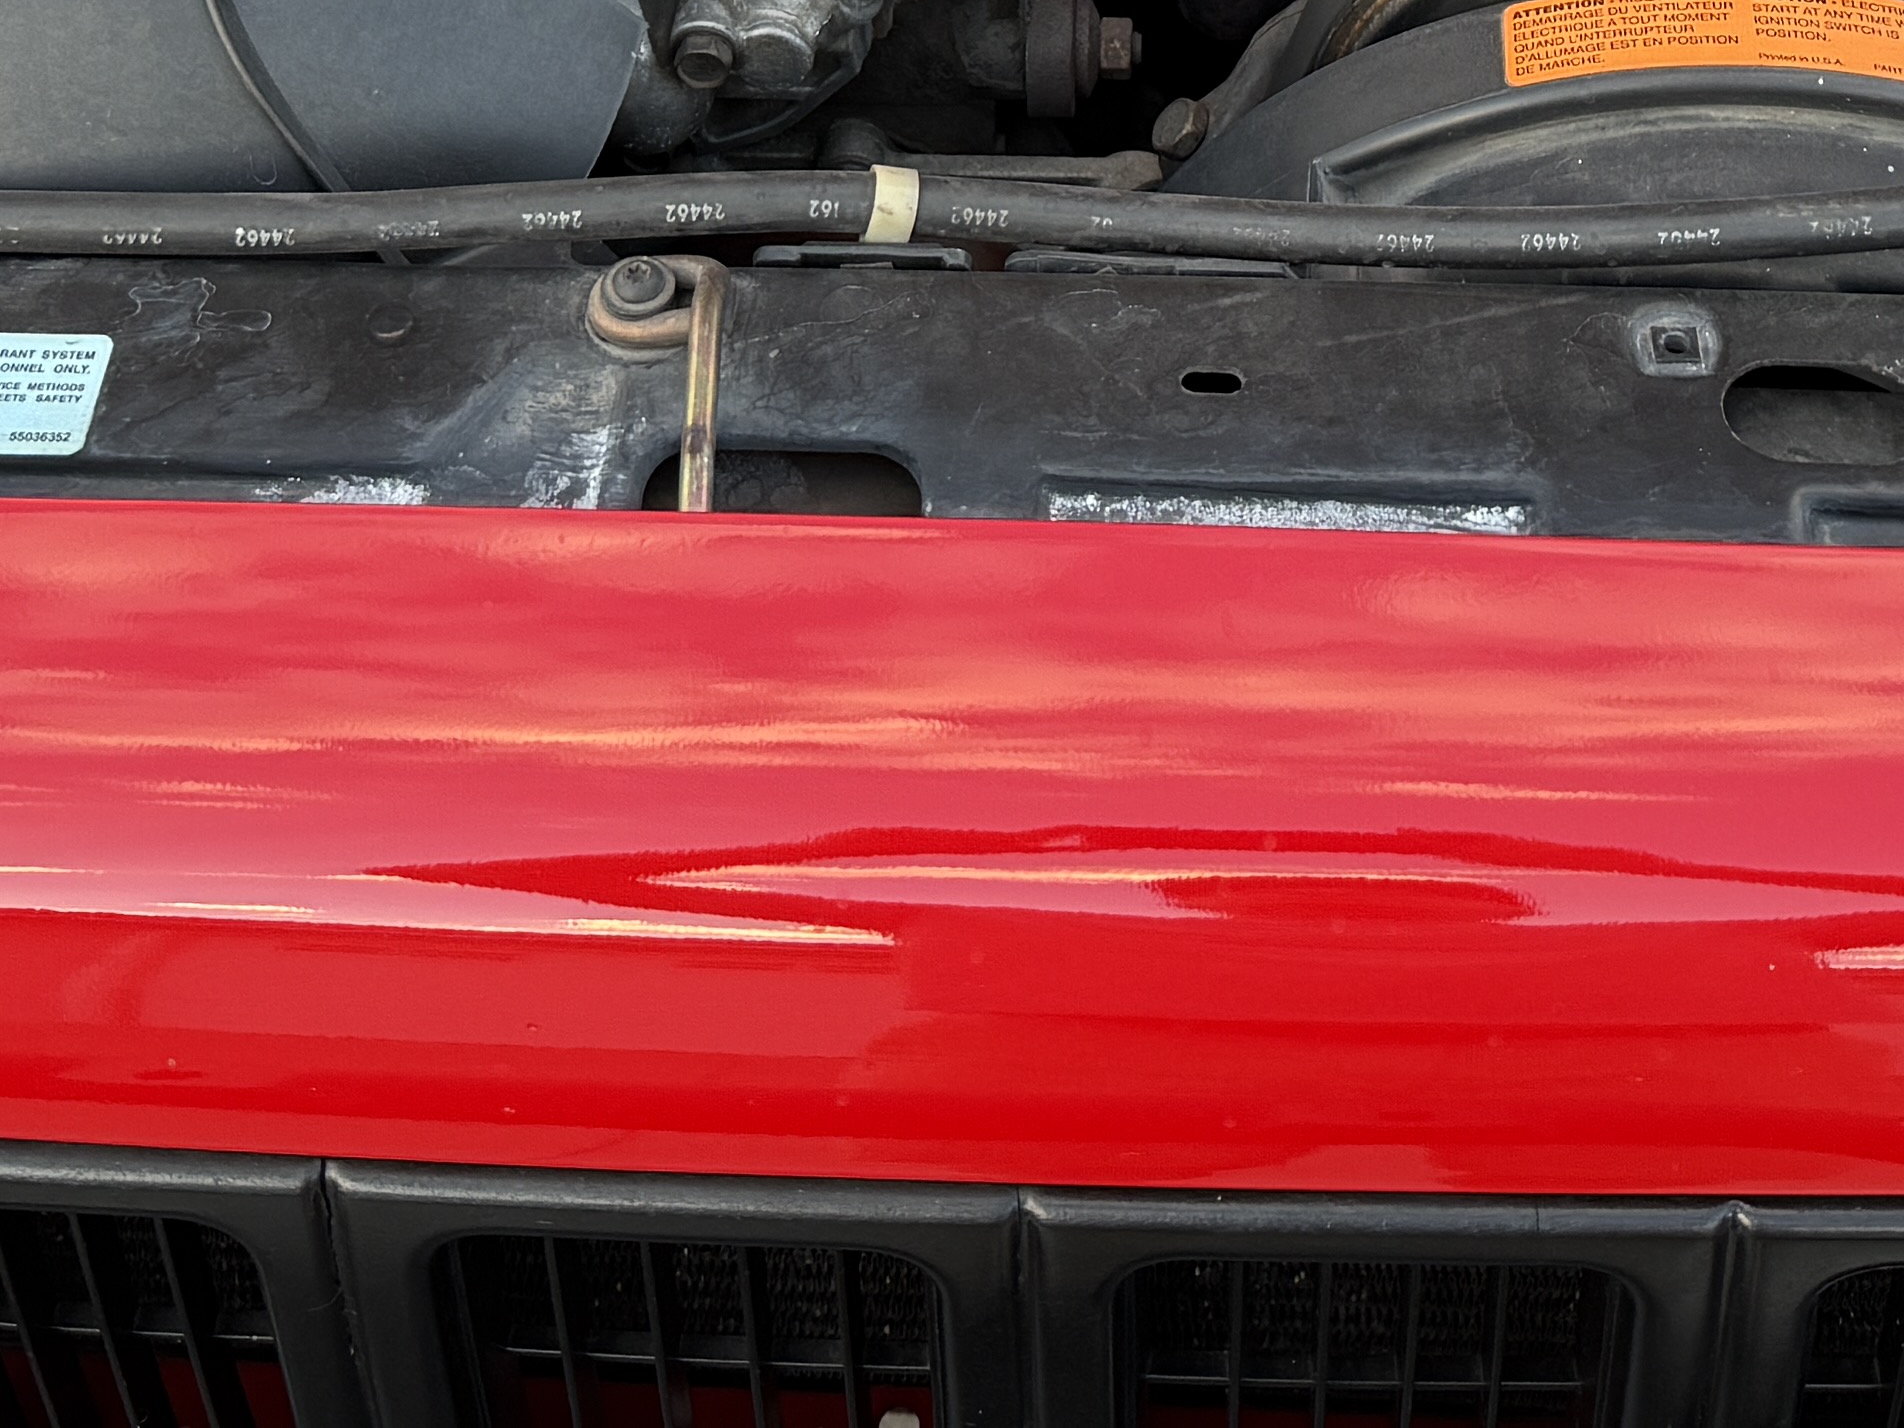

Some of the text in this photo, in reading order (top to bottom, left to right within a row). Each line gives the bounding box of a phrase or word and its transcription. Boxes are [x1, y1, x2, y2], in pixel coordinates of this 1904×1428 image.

[1513, 0, 1734, 30] DEMARRAGE DU VENTILATEUR
[1753, 3, 1802, 14] START
[1802, 5, 1820, 17] AT
[1823, 8, 1852, 22] ANY
[1855, 12, 1891, 27] TIME
[1514, 21, 1606, 42] ELECTRIQUE
[1620, 14, 1659, 26] TOUT
[1663, 12, 1730, 23] MOMENT
[1753, 15, 1820, 31] IGNITION
[1823, 21, 1882, 38] SWITCH
[1885, 29, 1900, 39] IS
[1755, 28, 1832, 43] POSITION.
[1515, 24, 1694, 54] QUAND L'INTERRUPTEUR
[1516, 34, 1739, 64] D'ALLUMAGE EST EN POSITION
[1759, 52, 1809, 63] Printed in
[1515, 54, 1605, 75] DE MARCHE.
[1873, 62, 1902, 75] PART
[665, 203, 725, 221] 24462
[234, 227, 295, 245] 24462
[1520, 232, 1581, 251] 24462
[41, 349, 96, 361] SYSTEM
[53, 364, 91, 375] ONLY.
[27, 382, 85, 393] METHODS
[36, 394, 82, 404] SAFETY
[9, 430, 71, 443] 55036352
